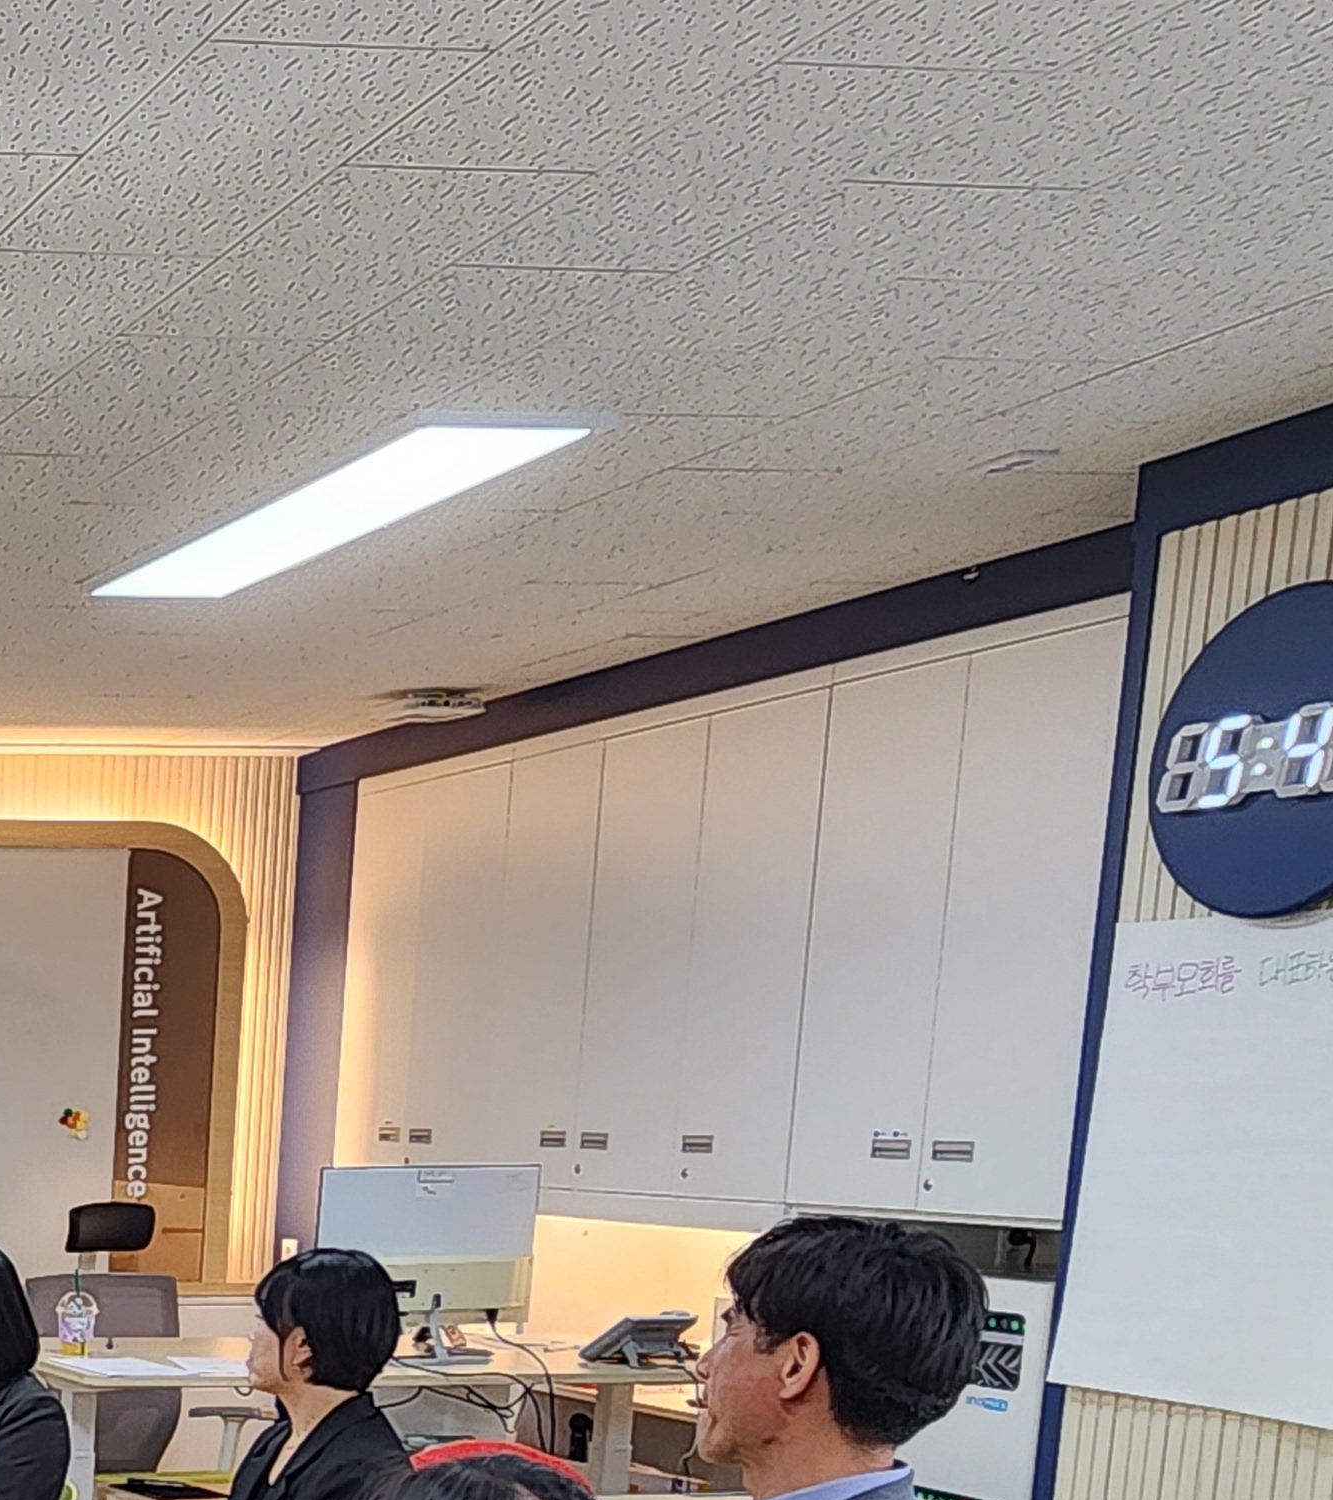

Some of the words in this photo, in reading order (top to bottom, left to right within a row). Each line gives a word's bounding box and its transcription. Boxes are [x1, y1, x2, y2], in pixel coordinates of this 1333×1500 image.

[132, 888, 164, 1018] Artificial
[1124, 955, 1242, 1001] 학부모회를
[125, 1027, 158, 1197] Intelligence
